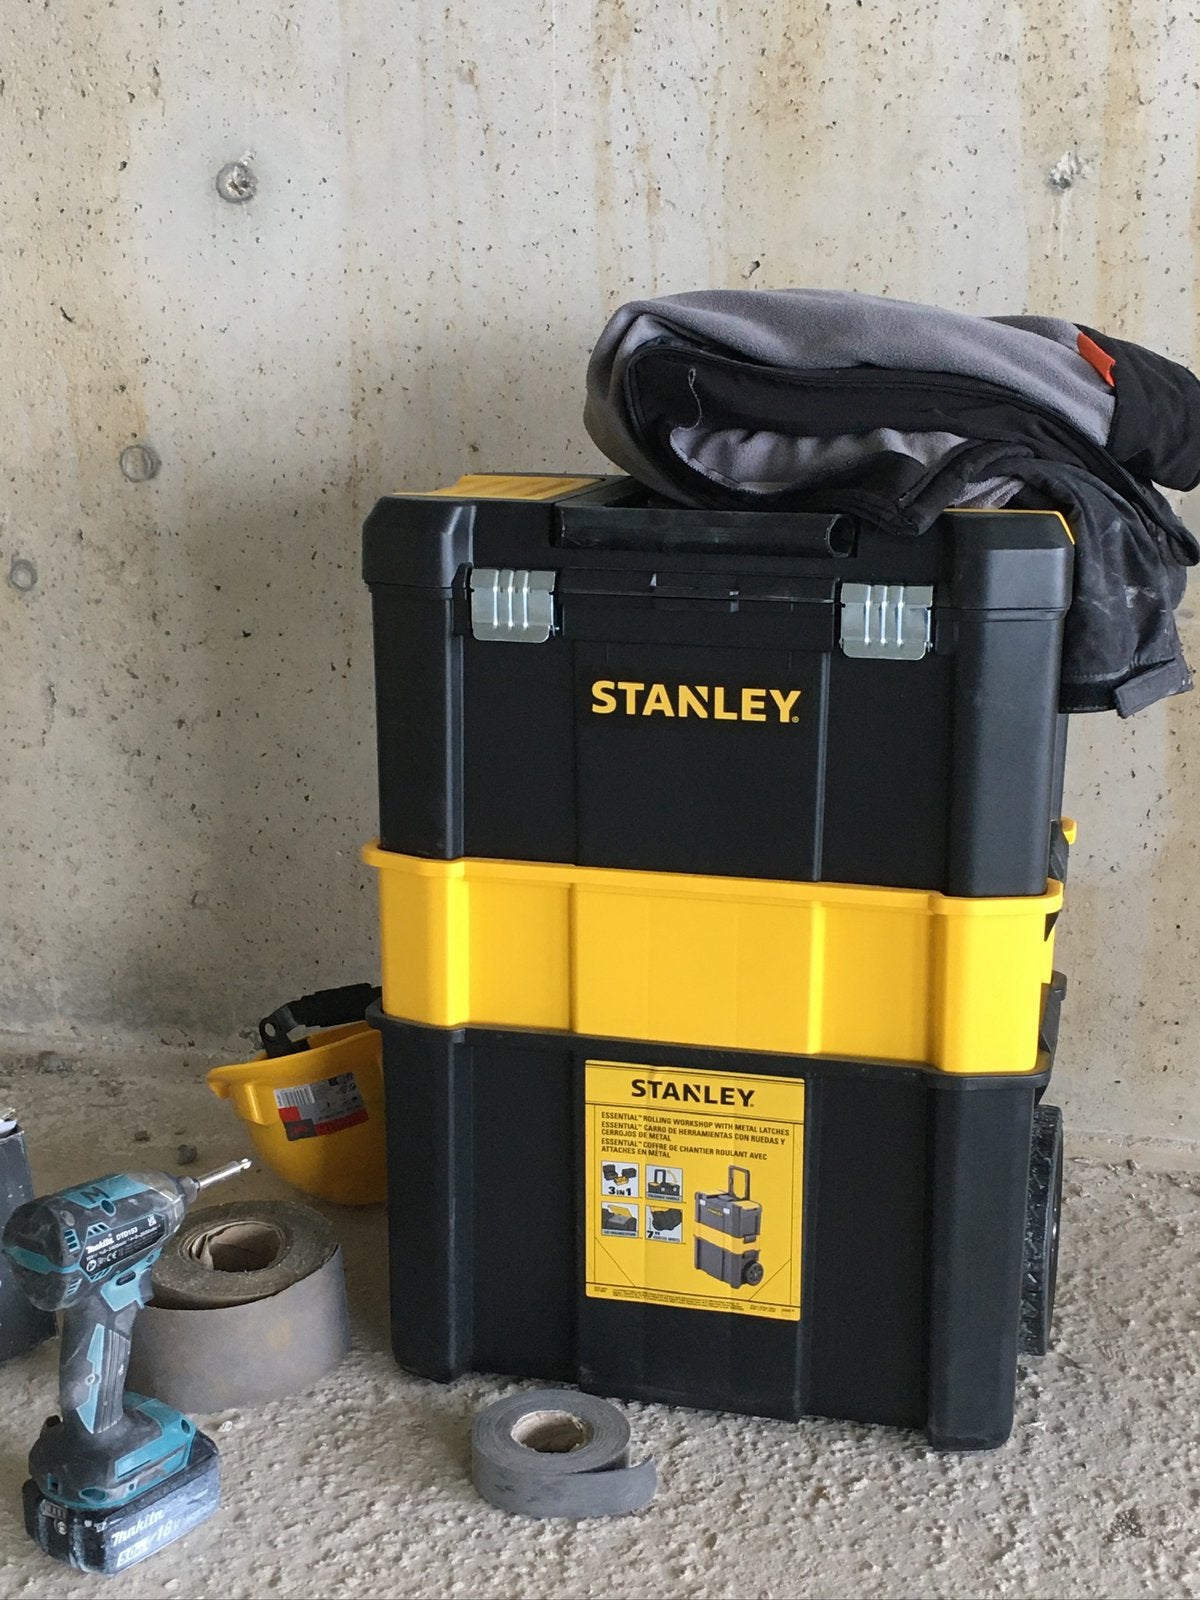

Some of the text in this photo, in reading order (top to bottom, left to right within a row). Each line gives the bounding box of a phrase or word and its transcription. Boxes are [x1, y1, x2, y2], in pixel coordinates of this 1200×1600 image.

[643, 1115, 671, 1124] ROLLING
[673, 1118, 713, 1128] WORKSHOP
[714, 1121, 733, 1130] WITH
[734, 1124, 758, 1133] METAL
[759, 1126, 790, 1136] LATCHES
[601, 1129, 637, 1138] CERROJOS
[648, 1132, 671, 1141] METAL
[643, 1124, 666, 1133] CARRO
[678, 1128, 733, 1139] HERRAMIENTAS
[734, 1133, 750, 1141] CON
[751, 1135, 779, 1145] RUEDAS
[601, 1146, 635, 1154] ATTACHES
[643, 1141, 667, 1150] COFFRE
[679, 1145, 714, 1155] CHANTIER
[715, 1148, 747, 1158] ROULANT
[749, 1152, 767, 1160] AVEC
[608, 1186, 615, 1194] 3
[626, 1188, 631, 1196] 1
